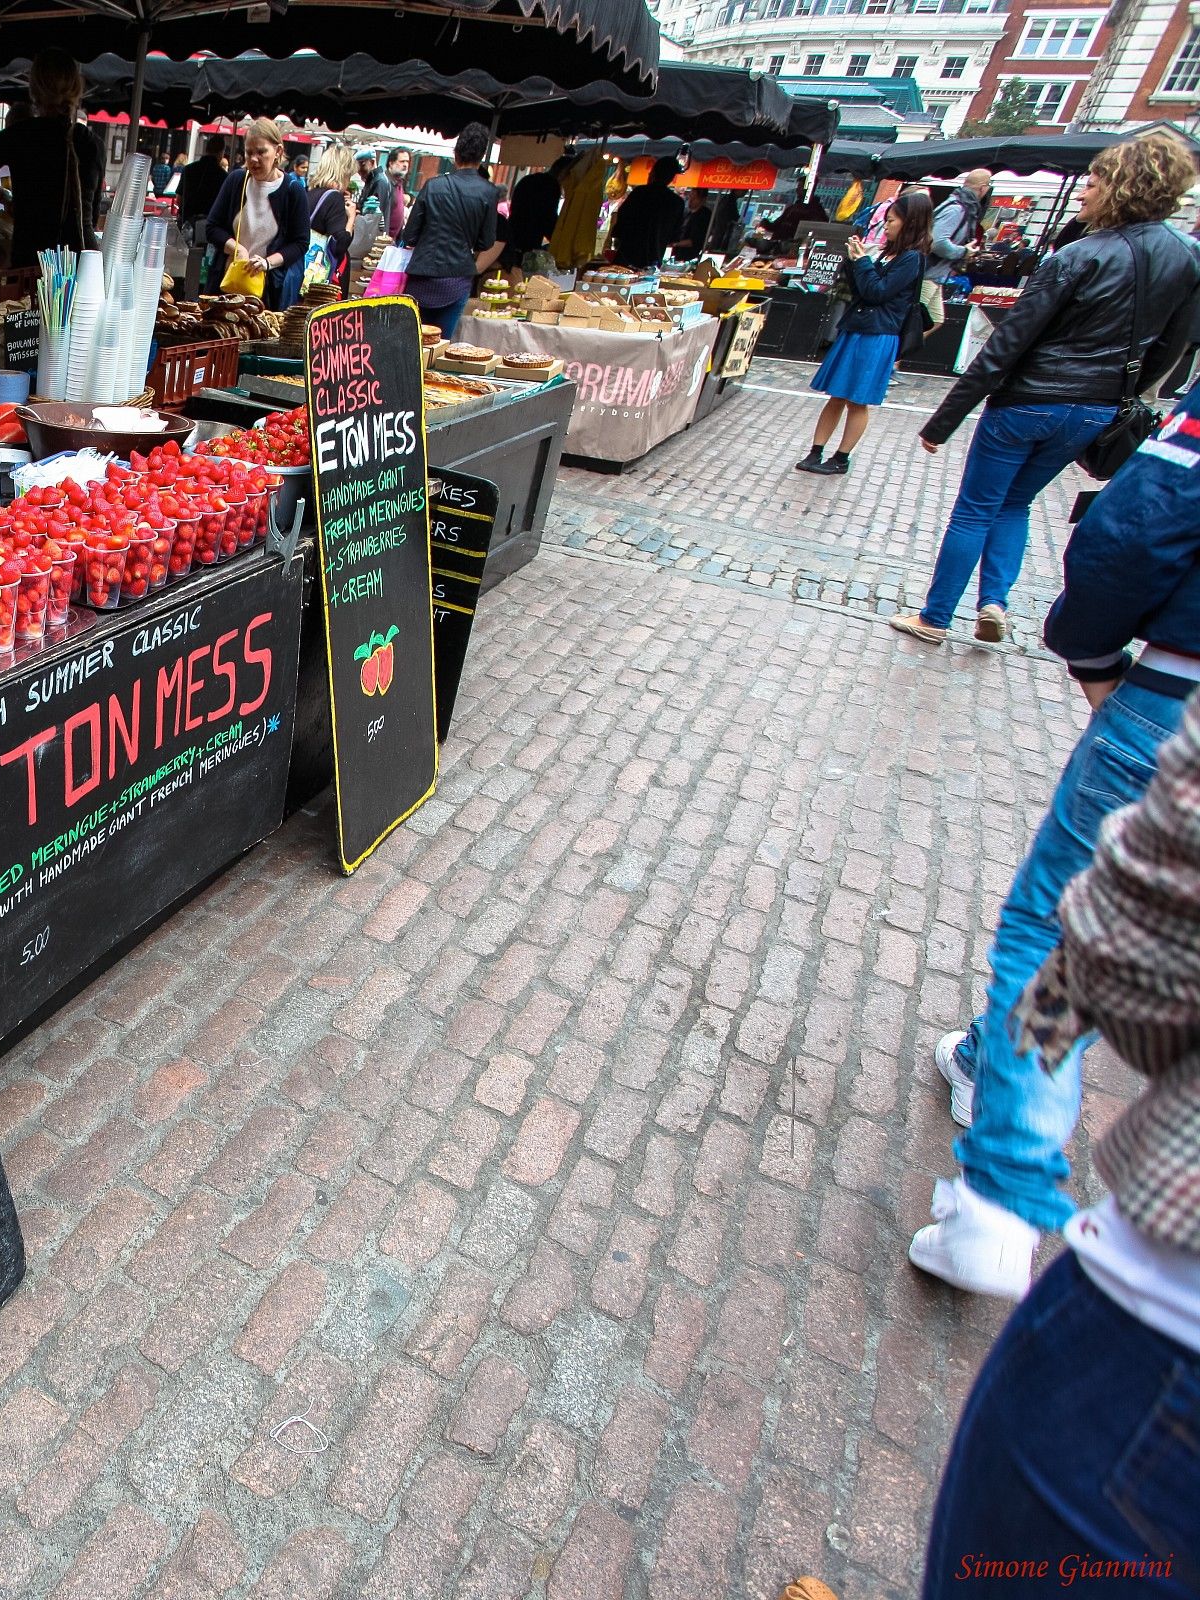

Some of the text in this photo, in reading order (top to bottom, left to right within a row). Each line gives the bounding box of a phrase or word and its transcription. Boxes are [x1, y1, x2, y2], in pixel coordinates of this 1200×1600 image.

[702, 175, 769, 186] MOZZARELLA
[827, 254, 842, 262] COLD
[6, 312, 23, 322] SAINT
[311, 311, 364, 350] BRITISH
[311, 343, 374, 386] SUMMER
[316, 380, 383, 417] CLASSIC
[315, 410, 416, 475] ETON MESS
[322, 465, 406, 514] HANDMADE GIANT
[324, 486, 425, 553] FRENCH MERINGUES
[25, 641, 114, 713] SUMMER
[132, 606, 202, 657] CLASSIC
[154, 611, 273, 749] MESS
[0, 879, 33, 919] WITH
[39, 828, 106, 887] HANDMADE
[109, 797, 147, 835] GIANT
[150, 767, 193, 808] FRENCH
